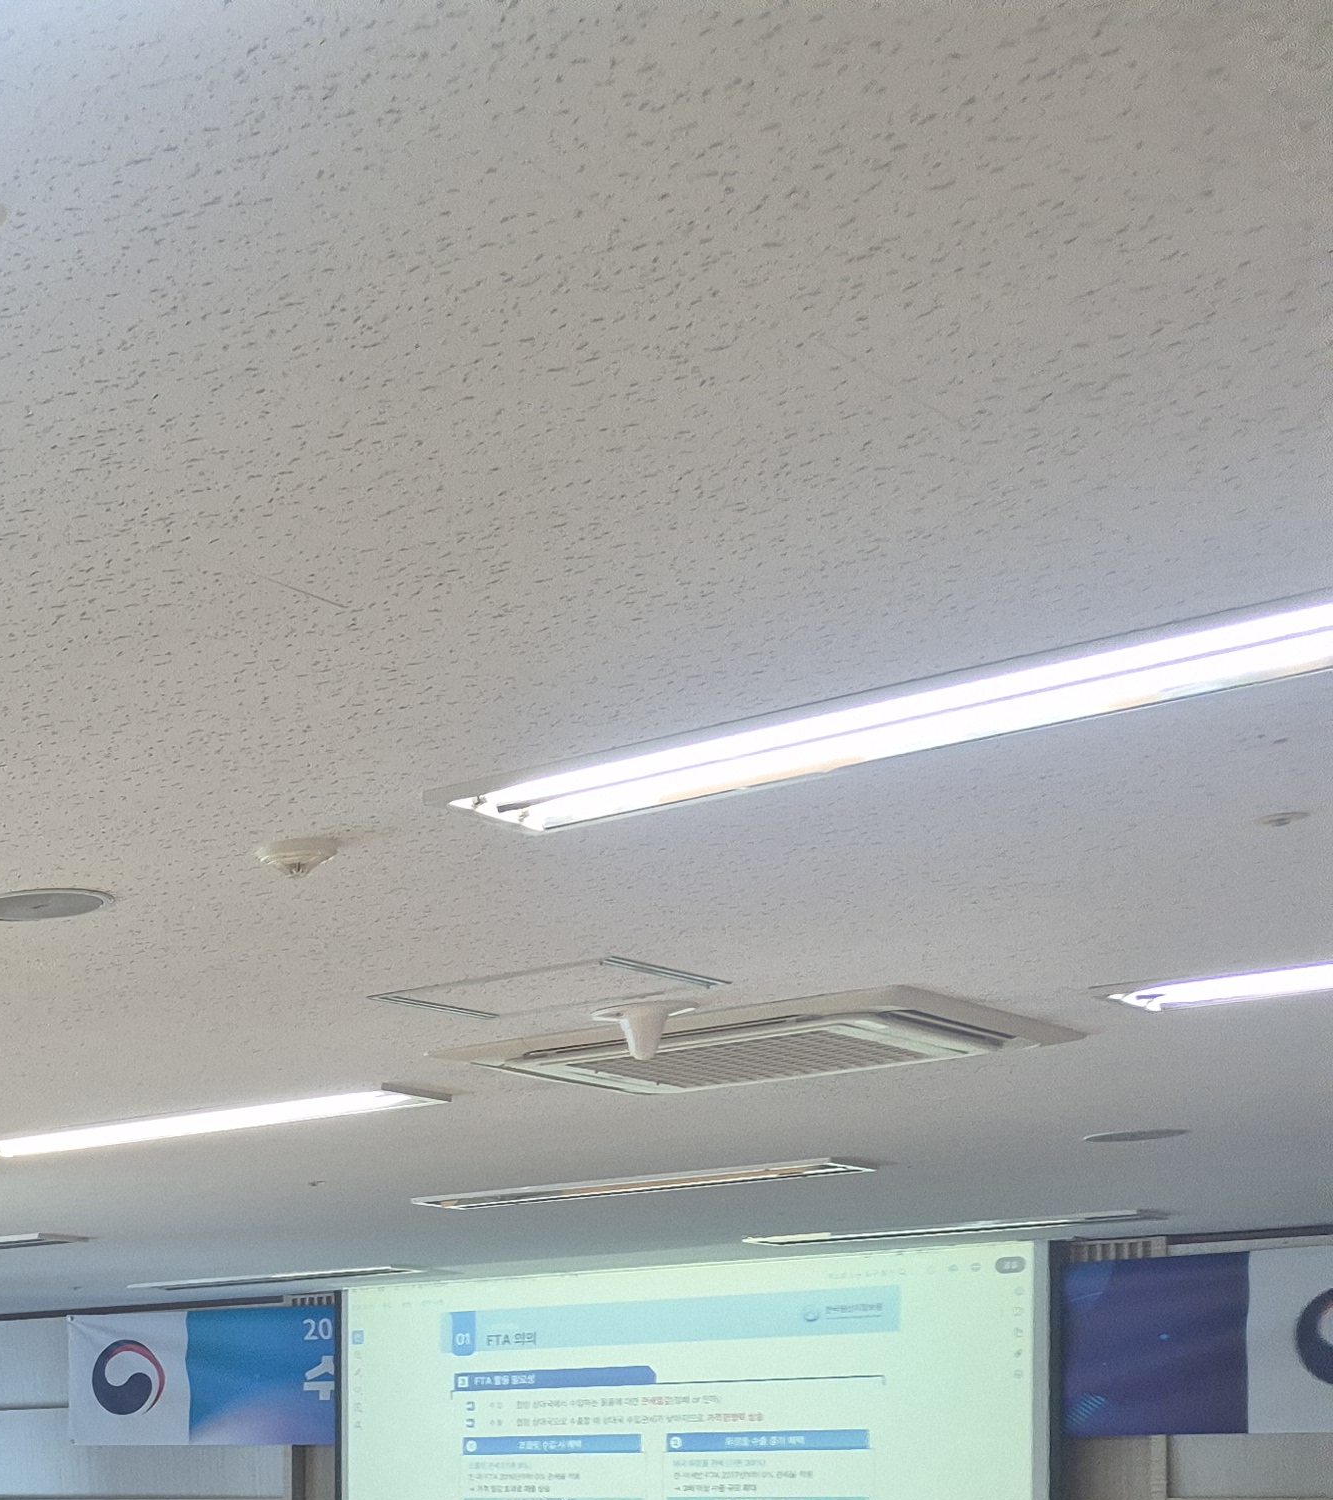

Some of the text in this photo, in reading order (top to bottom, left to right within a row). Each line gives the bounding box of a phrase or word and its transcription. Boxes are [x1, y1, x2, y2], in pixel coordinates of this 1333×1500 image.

[455, 1333, 471, 1346] 01
[486, 1331, 537, 1346] FTA 의의
[474, 1376, 493, 1385] FTA
